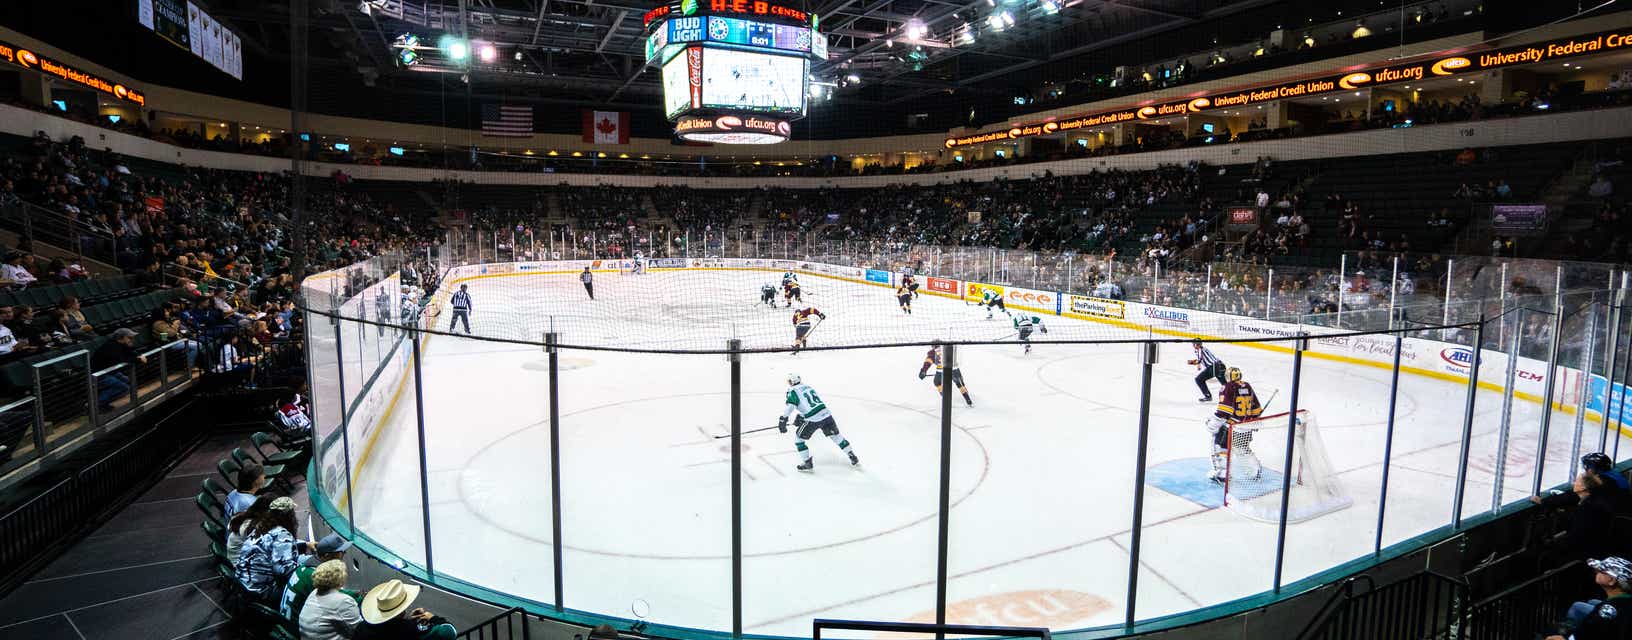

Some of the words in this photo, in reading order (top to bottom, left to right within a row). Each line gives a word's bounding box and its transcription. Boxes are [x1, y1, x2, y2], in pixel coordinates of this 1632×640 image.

[712, 0, 768, 14] H-E-B
[771, 6, 806, 22] CENTER
[676, 18, 700, 30] BUD
[673, 29, 702, 42] LIGHT
[1480, 48, 1545, 67] University
[1548, 36, 1602, 57] Federal
[41, 59, 67, 79] University
[68, 69, 86, 83] Federal
[86, 76, 100, 88] Credit
[688, 48, 702, 87] Coca-Cola
[1375, 66, 1424, 83] ufcu.org
[1060, 119, 1083, 130] University
[1082, 115, 1101, 126] Federal
[1101, 114, 1118, 124] Credit
[1118, 111, 1135, 121] Union
[1158, 103, 1187, 115] ufcu.org
[1214, 94, 1250, 106] University
[1250, 87, 1279, 101] Federal
[1280, 84, 1306, 97] Credit
[1307, 80, 1334, 93] Union
[692, 119, 712, 129] Union
[745, 118, 776, 132] ufcu.org
[1144, 306, 1188, 321] EXCALIBUR
[1239, 325, 1260, 334] THANK
[1262, 328, 1275, 336] YOU
[1449, 350, 1474, 363] AH
[1515, 369, 1545, 383] CM
